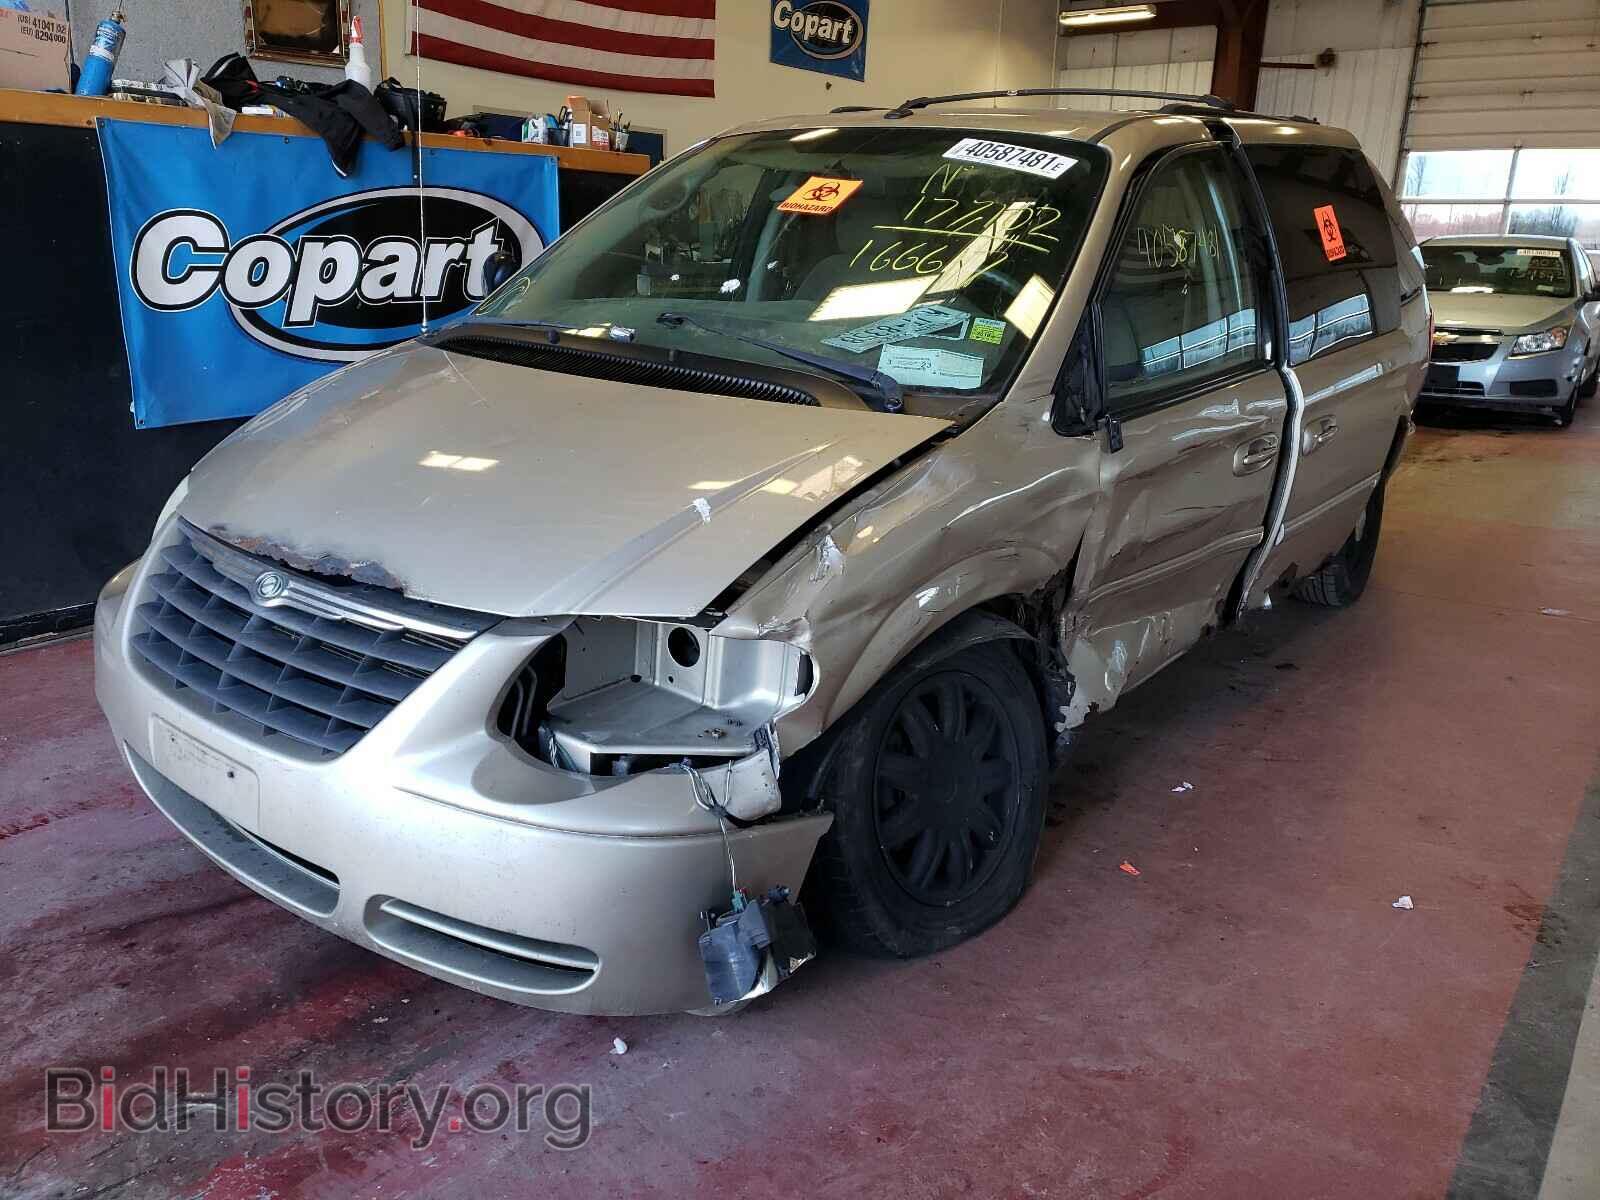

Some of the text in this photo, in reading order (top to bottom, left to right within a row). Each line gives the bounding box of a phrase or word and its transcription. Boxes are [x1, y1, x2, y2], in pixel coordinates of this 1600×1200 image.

[773, 0, 853, 45] Copart
[964, 142, 1059, 170] 40587481
[780, 202, 834, 213] BIOHAZARD
[130, 208, 503, 328] Copart
